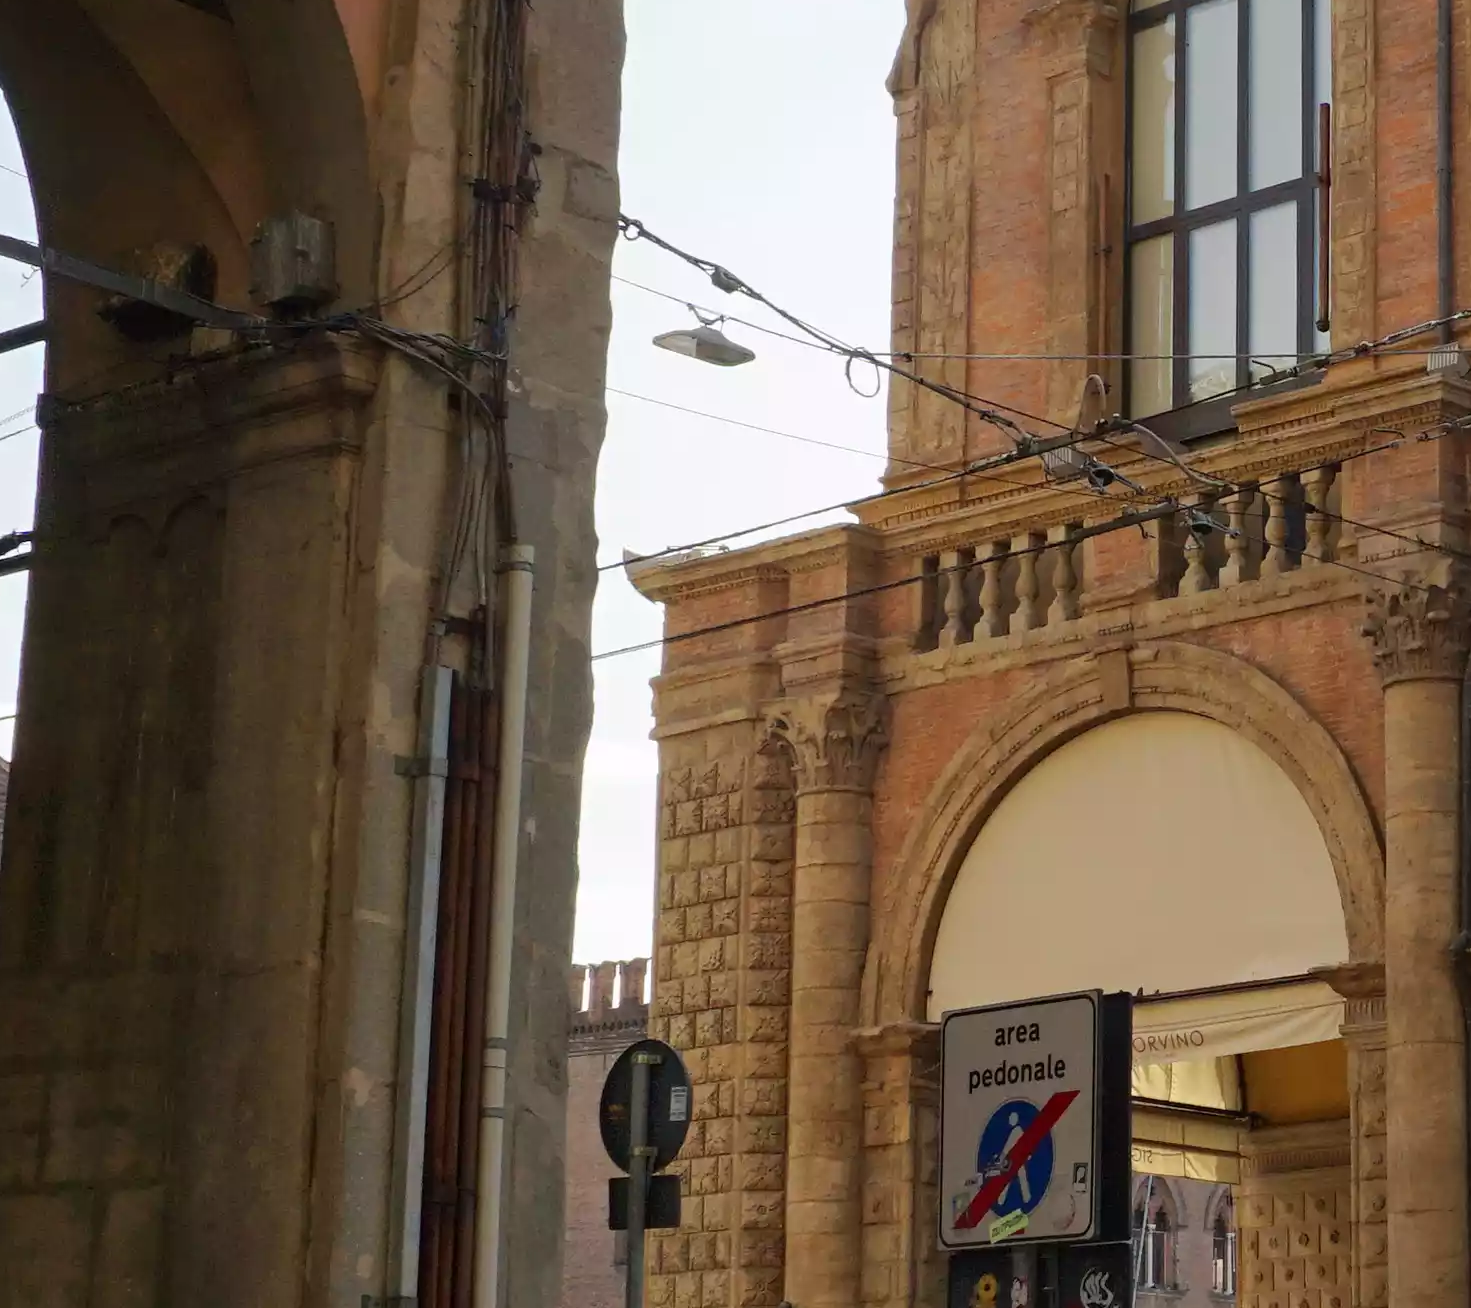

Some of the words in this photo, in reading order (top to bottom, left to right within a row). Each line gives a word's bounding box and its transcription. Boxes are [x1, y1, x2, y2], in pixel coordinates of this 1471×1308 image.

[994, 1023, 1040, 1046] area
[1132, 1030, 1204, 1052] ORVINO
[968, 1053, 1066, 1094] pedonale
